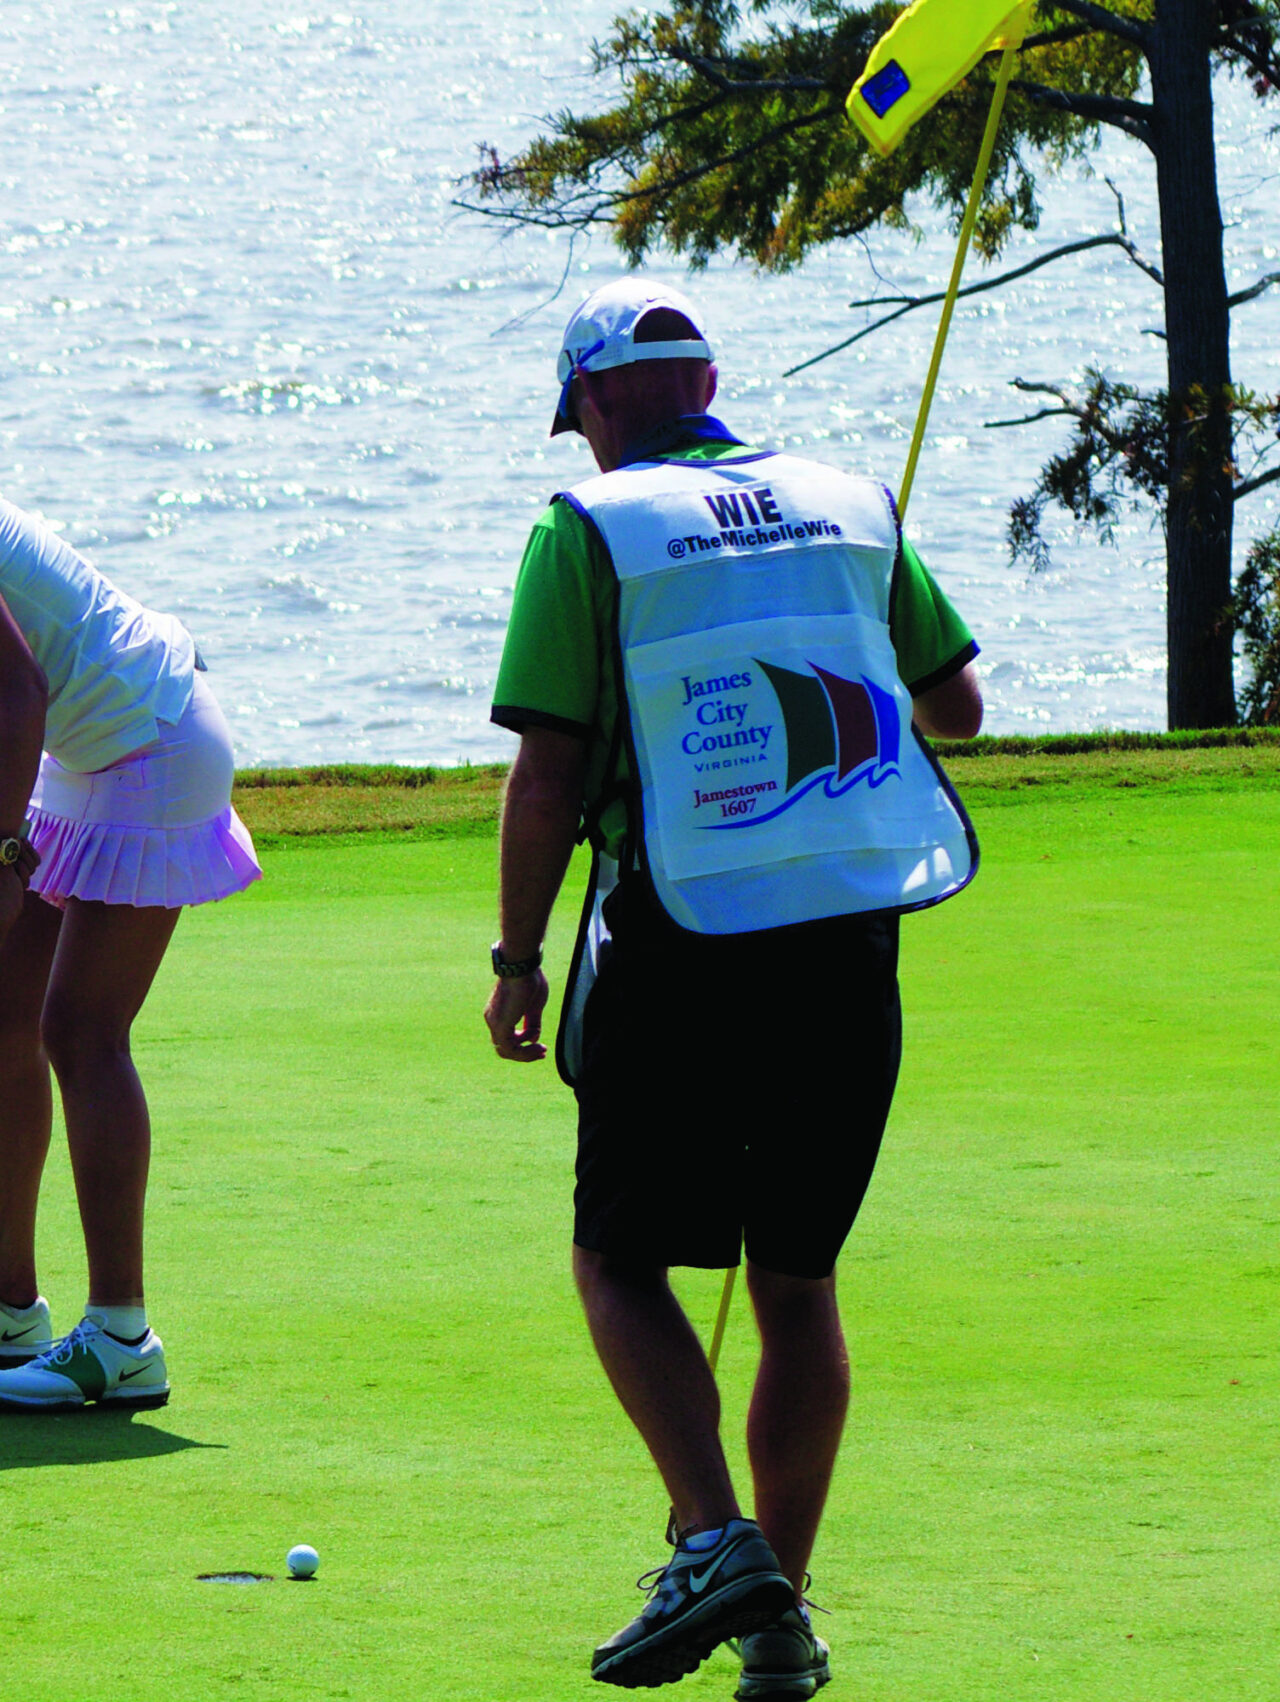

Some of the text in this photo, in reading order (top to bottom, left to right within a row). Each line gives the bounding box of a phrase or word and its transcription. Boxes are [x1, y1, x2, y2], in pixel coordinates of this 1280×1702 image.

[704, 488, 783, 528] WIE
[667, 520, 842, 558] @TheMichelleWie
[681, 671, 752, 705] James
[696, 700, 748, 726] City
[681, 725, 773, 755] County
[694, 752, 768, 773] VIRGINIA
[693, 779, 777, 808] Jamestown
[720, 798, 757, 817] 1607
